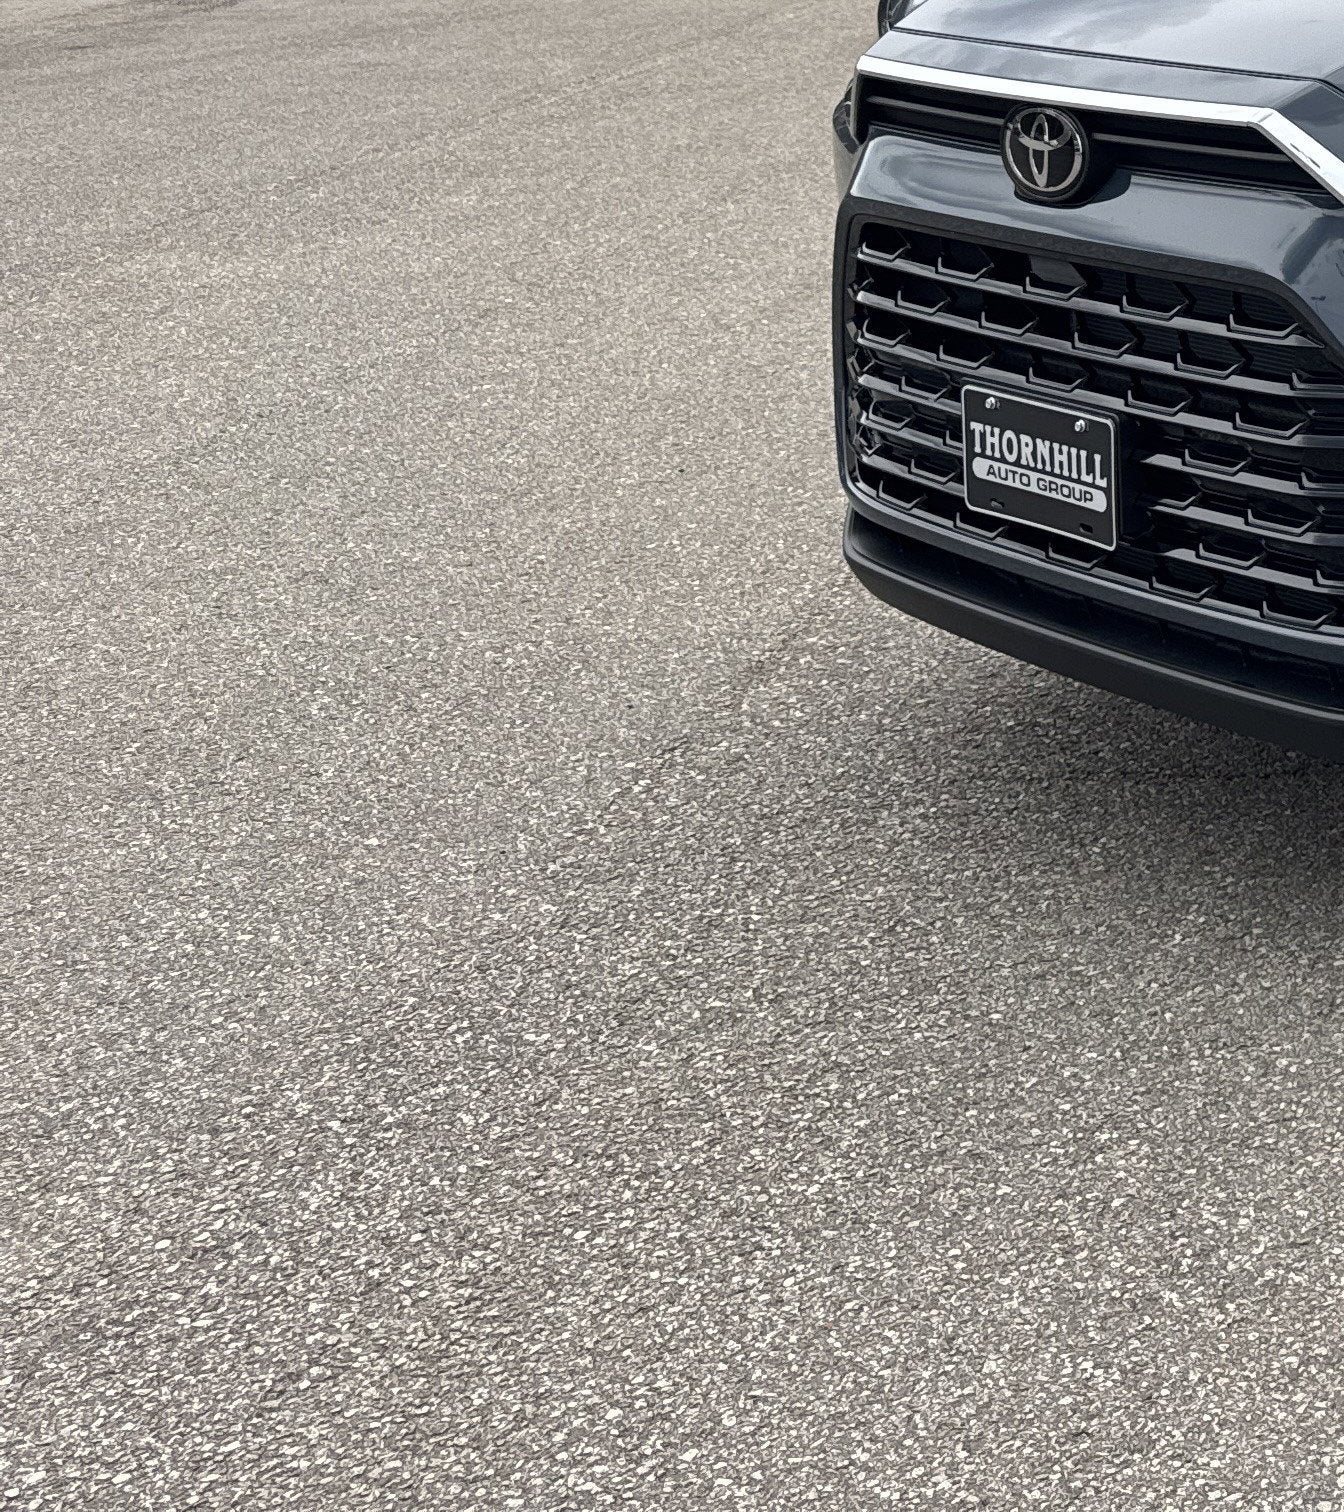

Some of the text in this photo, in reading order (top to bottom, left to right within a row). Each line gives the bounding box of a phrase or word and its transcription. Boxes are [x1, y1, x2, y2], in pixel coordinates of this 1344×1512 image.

[969, 420, 1108, 488] THORNHILL
[986, 464, 1094, 504] AUTO GROUP
